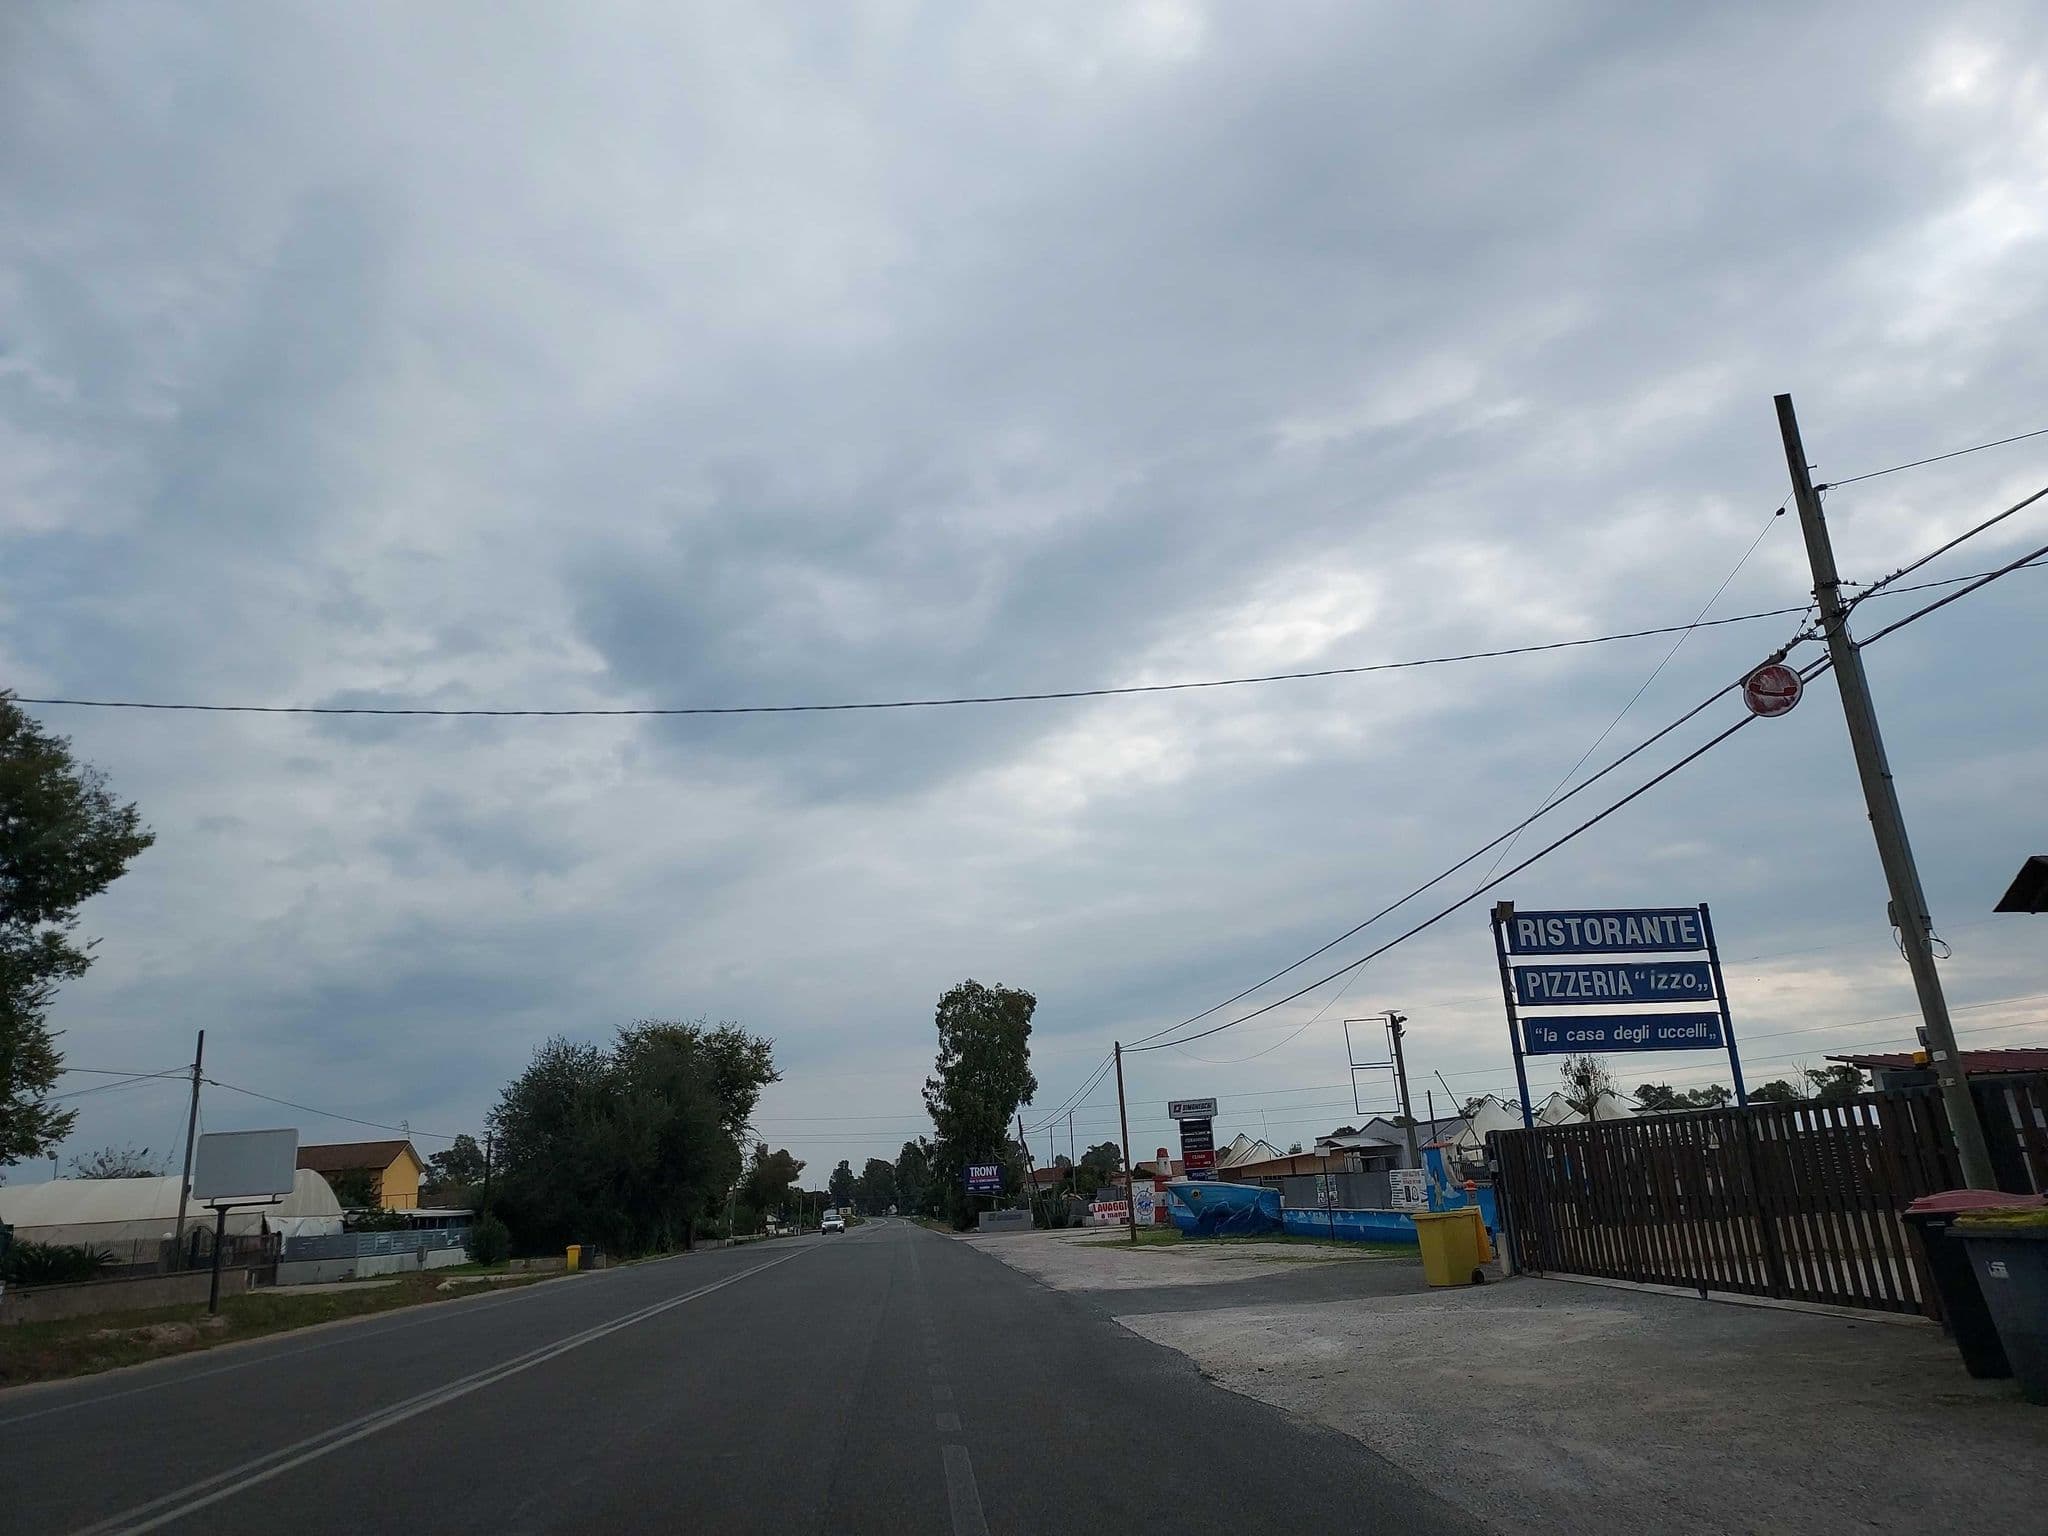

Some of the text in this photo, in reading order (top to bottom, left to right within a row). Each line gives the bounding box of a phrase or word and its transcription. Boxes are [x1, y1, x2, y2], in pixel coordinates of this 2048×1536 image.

[1517, 915, 1698, 947] RISTORANTE
[1526, 970, 1634, 998] PIZZERIA
[1566, 1028, 1605, 1042] casa
[1613, 1024, 1650, 1043] degli
[969, 1165, 998, 1177] TRONY
